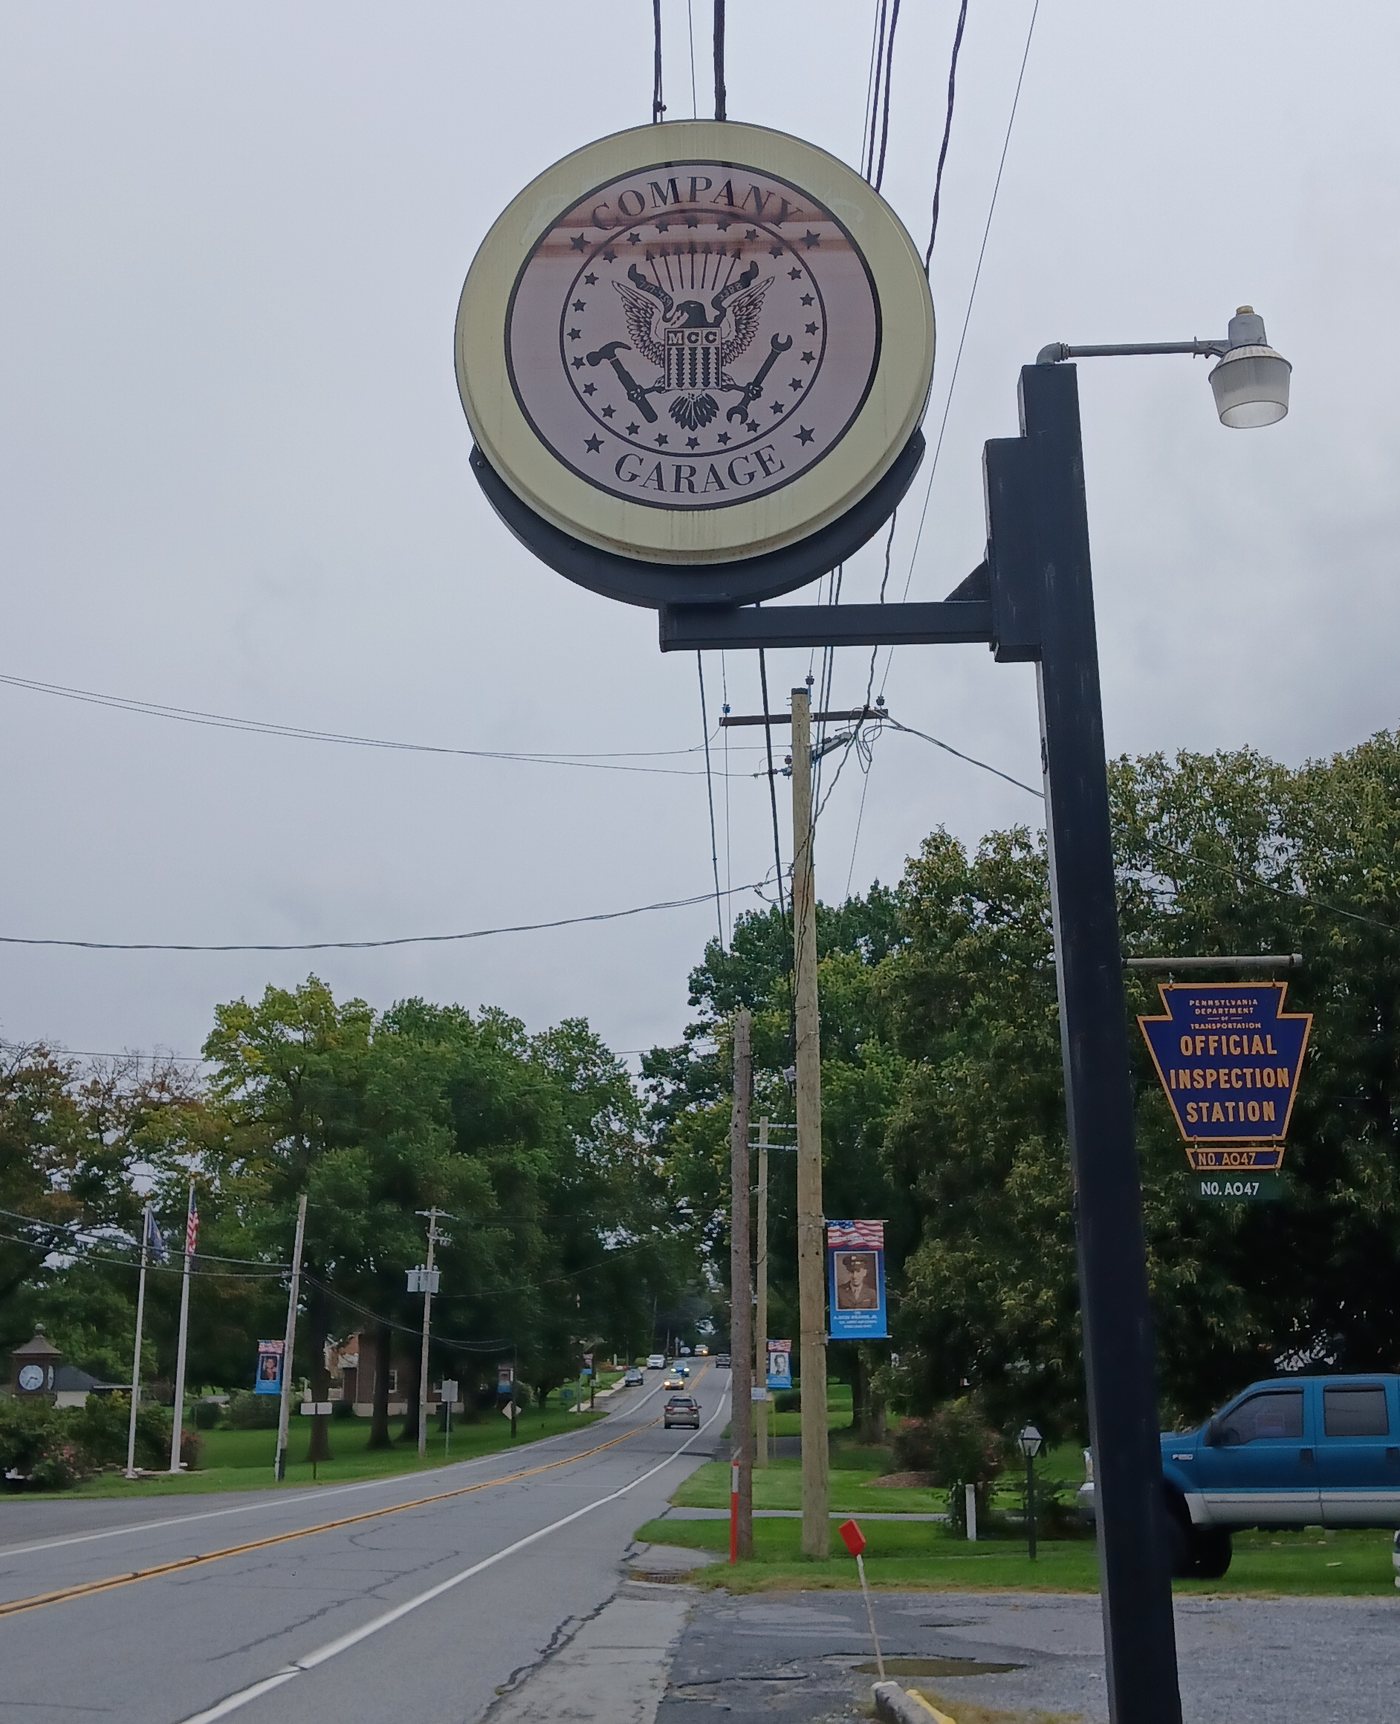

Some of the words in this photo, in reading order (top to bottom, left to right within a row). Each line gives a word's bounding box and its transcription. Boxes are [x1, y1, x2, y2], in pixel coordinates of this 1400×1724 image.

[591, 175, 804, 231] COMPANY
[667, 329, 718, 346] MCC
[614, 443, 786, 494] GARAGE
[1189, 998, 1258, 1007] PENNSYLVANIA
[1195, 1007, 1254, 1015] DEPARTMENT
[1190, 1022, 1262, 1030] TRANSPORTATION
[1180, 1034, 1278, 1056] OFFICIAL
[1169, 1067, 1290, 1089] INSPECTION
[1186, 1101, 1276, 1123] STATION
[1200, 1181, 1222, 1196] NO.
